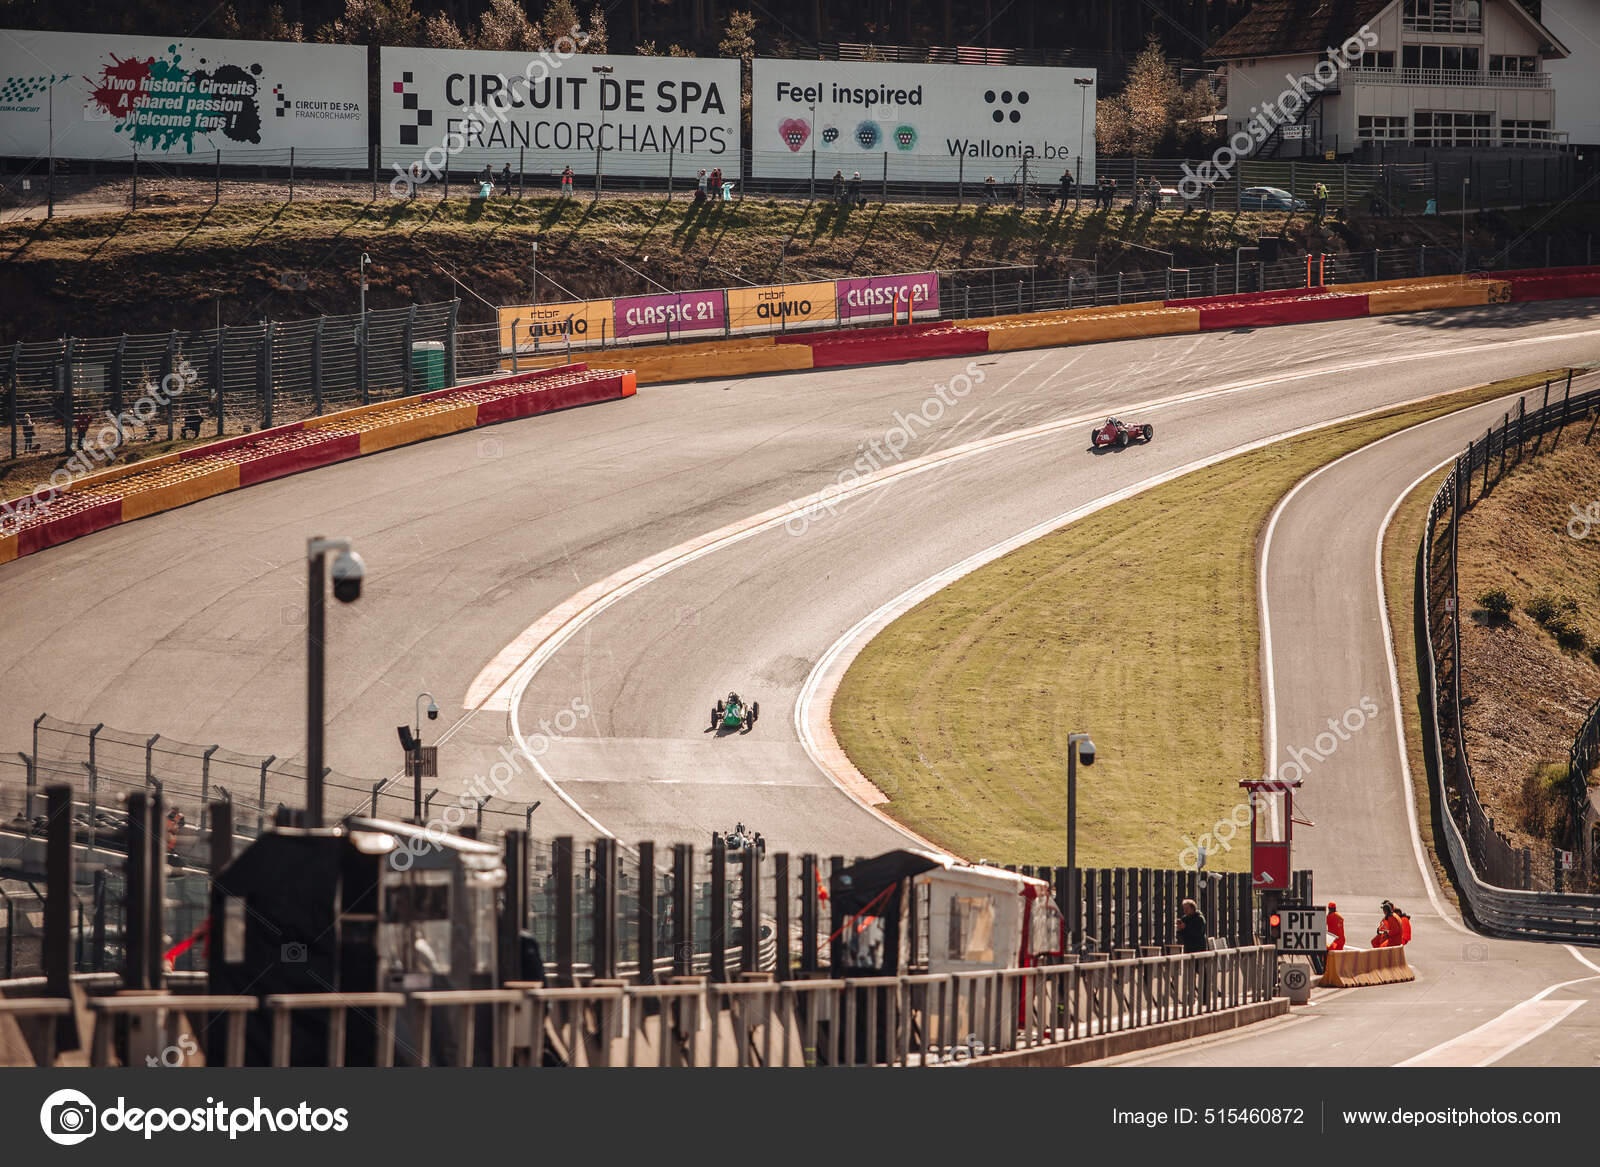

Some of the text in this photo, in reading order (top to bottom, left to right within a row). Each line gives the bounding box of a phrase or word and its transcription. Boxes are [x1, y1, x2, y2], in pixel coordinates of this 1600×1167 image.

[106, 75, 255, 96] Two historic Circuits
[445, 72, 726, 114] CIRCUIT DE SPA
[777, 82, 922, 108] Feel inspired
[117, 93, 243, 113] A shared passion
[295, 100, 360, 112] CIRCUIT DE SPA
[126, 110, 191, 128] Welcome
[194, 113, 227, 129] fans
[946, 139, 1070, 161] Wallonia.be
[847, 283, 929, 307] CLASSIC 21
[626, 301, 714, 326] CLASSIC 21
[757, 300, 812, 318] auvio
[1287, 911, 1316, 930] PIT
[1282, 931, 1321, 949] EXIT
